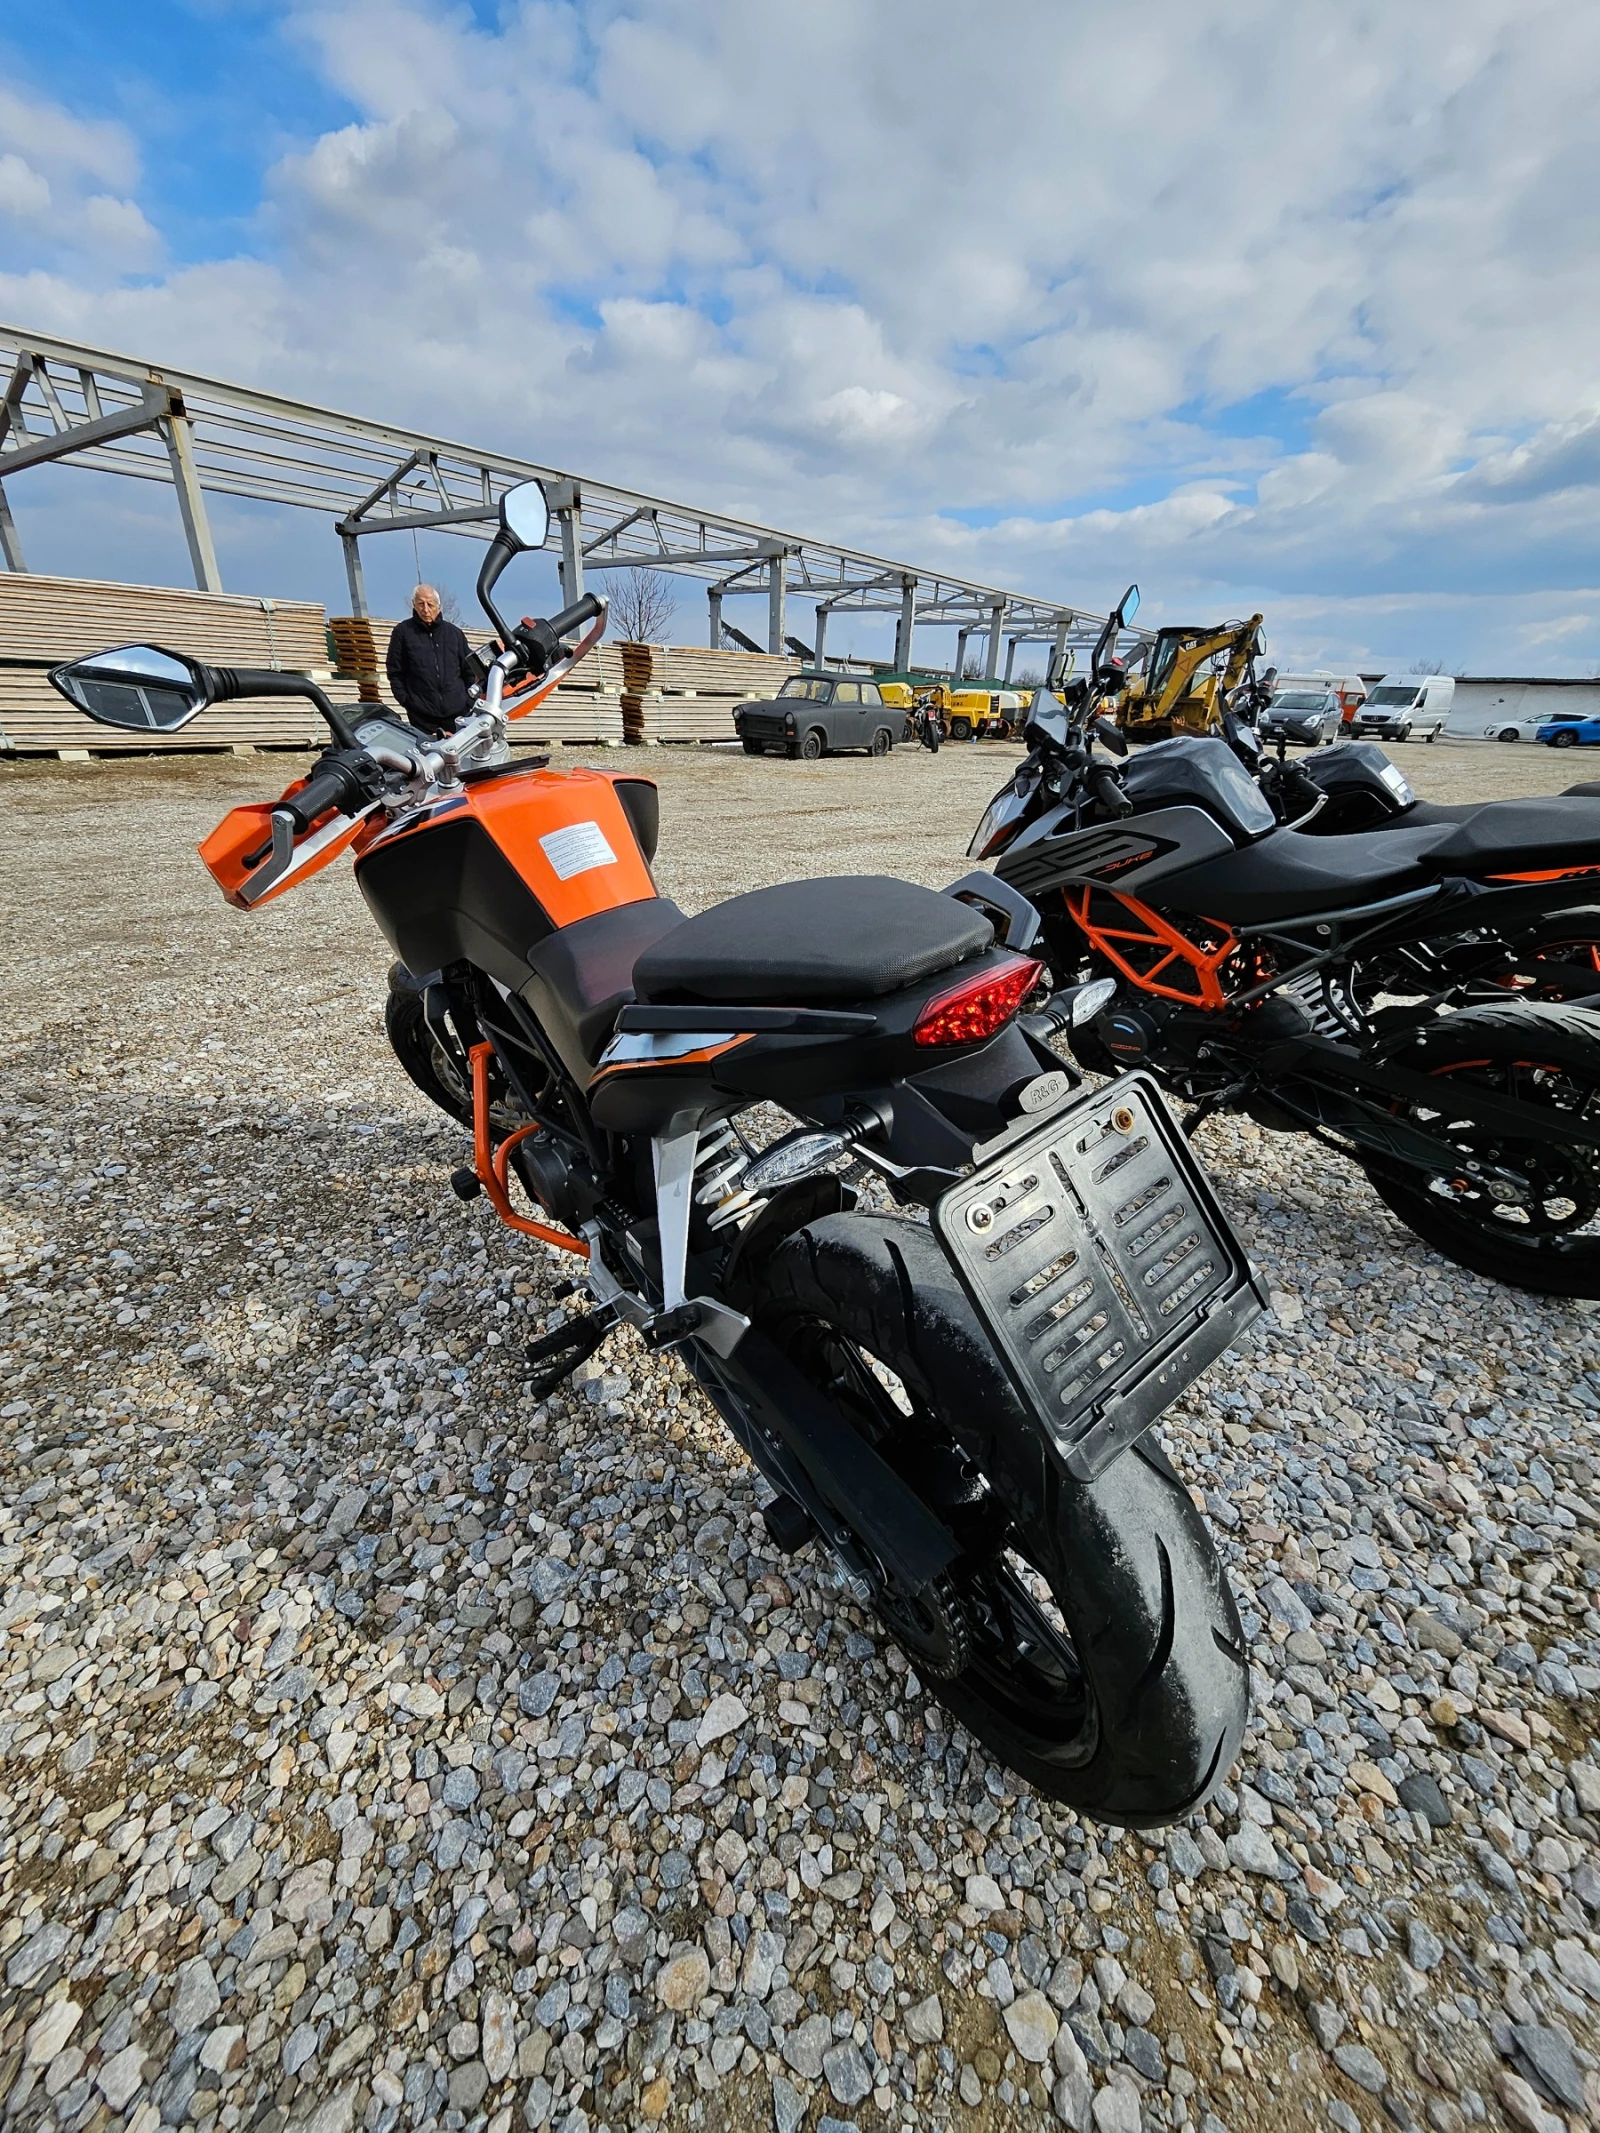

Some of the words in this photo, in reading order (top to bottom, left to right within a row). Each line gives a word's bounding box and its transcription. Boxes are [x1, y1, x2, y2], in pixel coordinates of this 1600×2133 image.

[1185, 640, 1198, 651] CAT
[1094, 850, 1154, 875] DUKE
[1030, 1079, 1059, 1105] R&G
